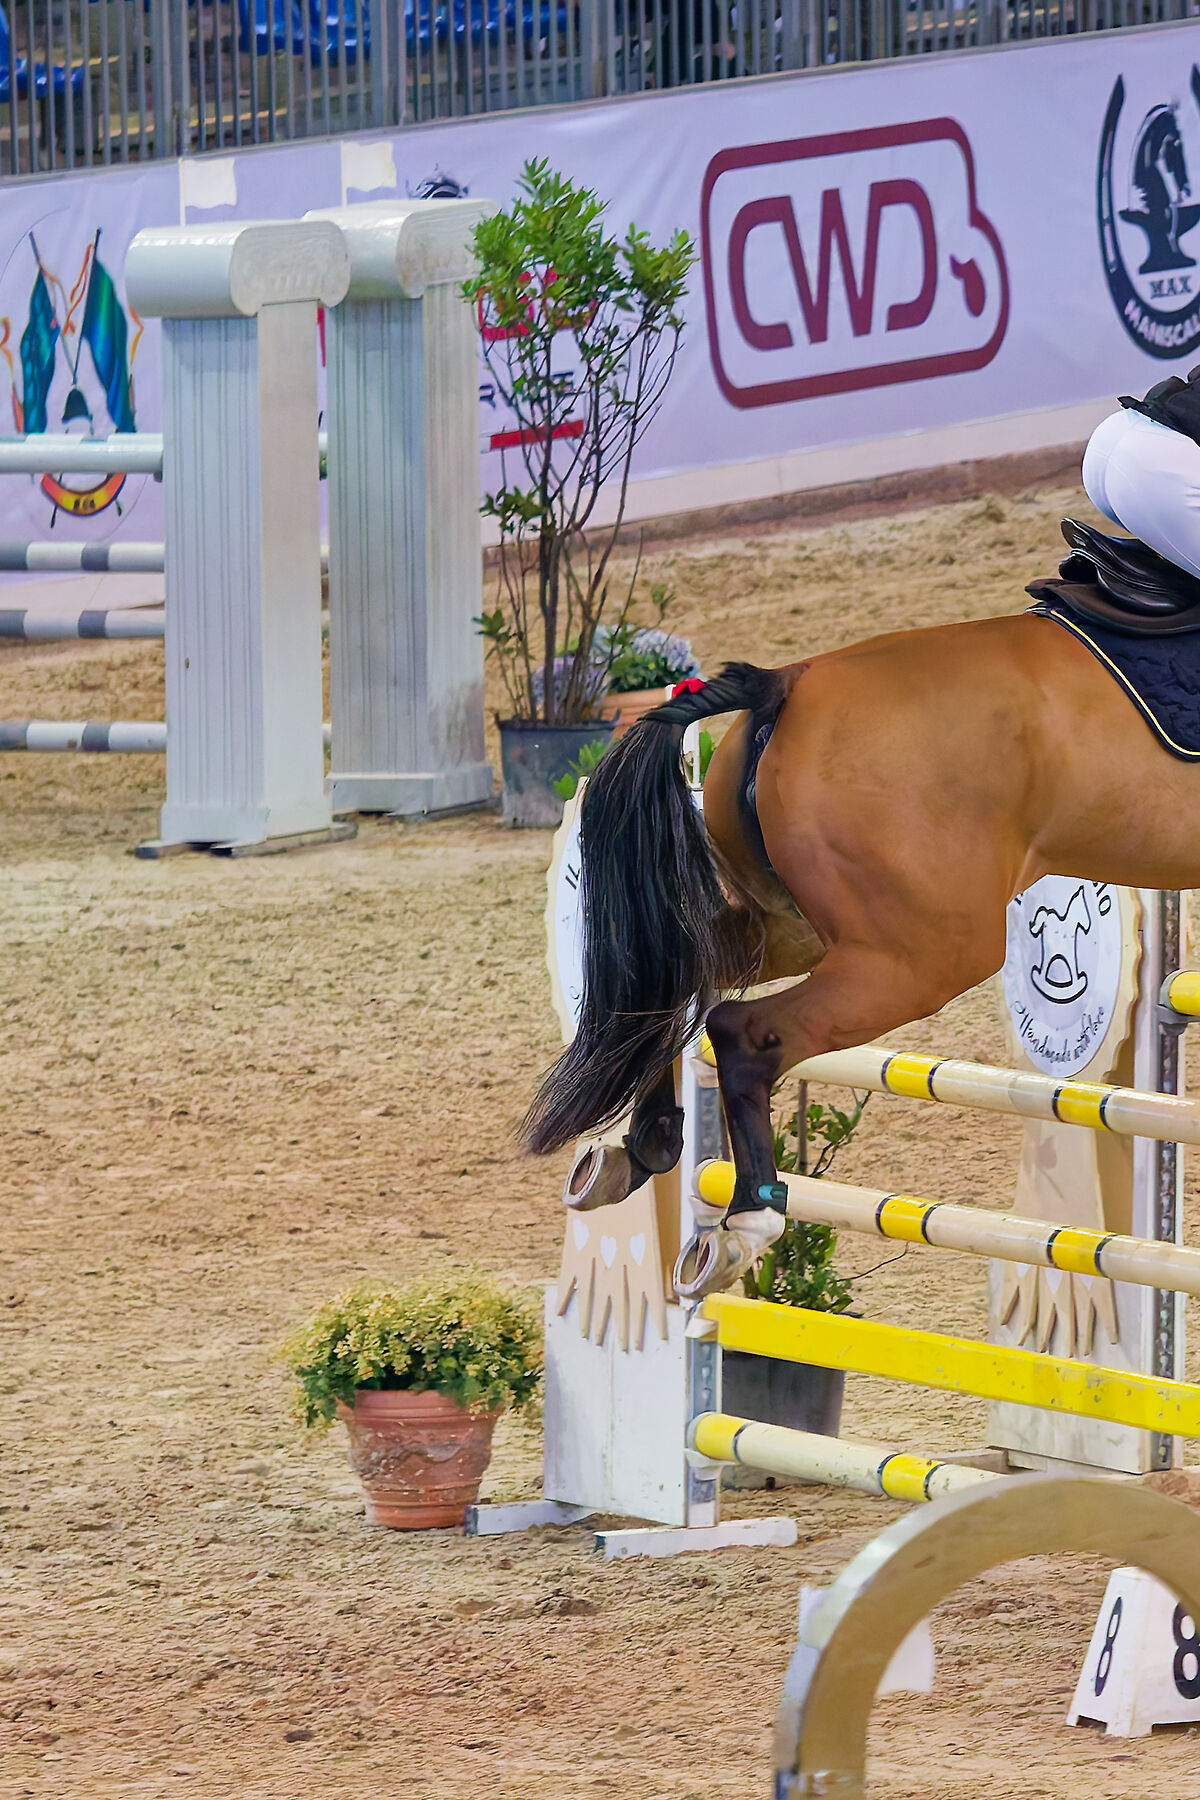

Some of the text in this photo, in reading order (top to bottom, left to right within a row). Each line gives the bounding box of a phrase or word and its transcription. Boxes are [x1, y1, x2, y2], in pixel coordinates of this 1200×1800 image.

[728, 178, 938, 351] CWD
[1149, 276, 1193, 300] MAX
[1094, 1596, 1122, 1695] 8
